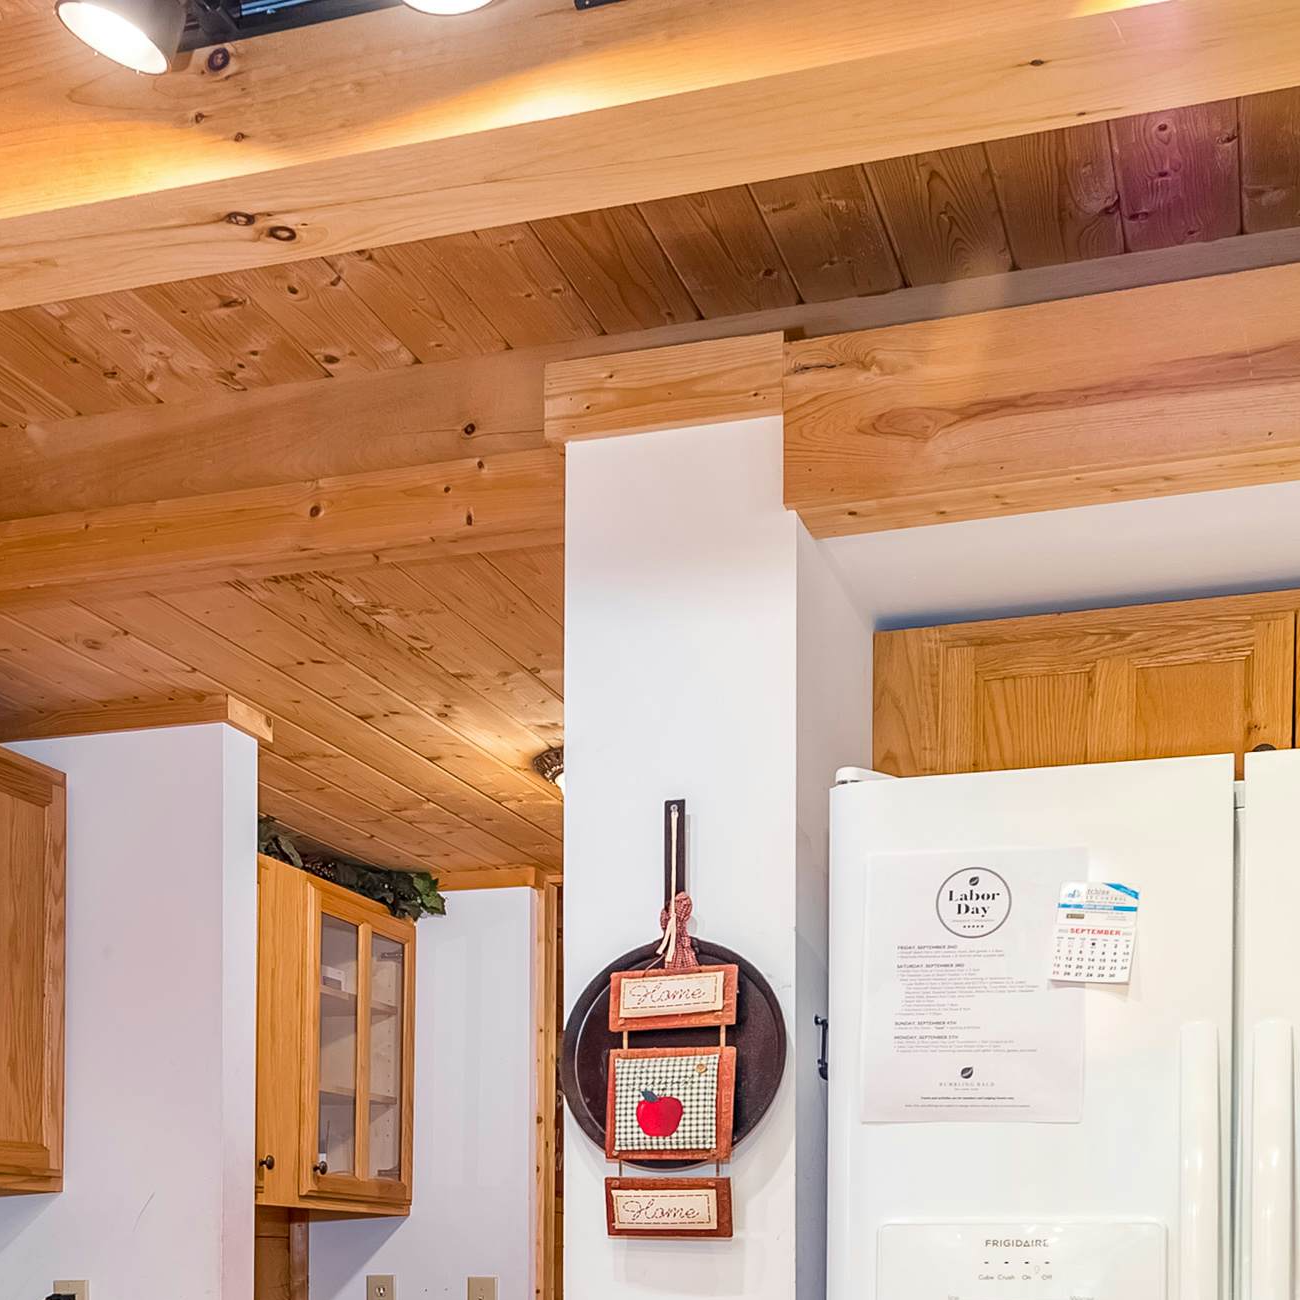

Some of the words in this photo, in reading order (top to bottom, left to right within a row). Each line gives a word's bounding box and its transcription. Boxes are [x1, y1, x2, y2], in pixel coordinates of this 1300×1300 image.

[948, 889, 1000, 901] Labor
[956, 903, 990, 918] Day
[1070, 927, 1122, 936] SEPTEMBER
[629, 982, 706, 1006] Home
[622, 1199, 700, 1221] Home
[985, 1239, 1049, 1248] FRIGIDAIRE
